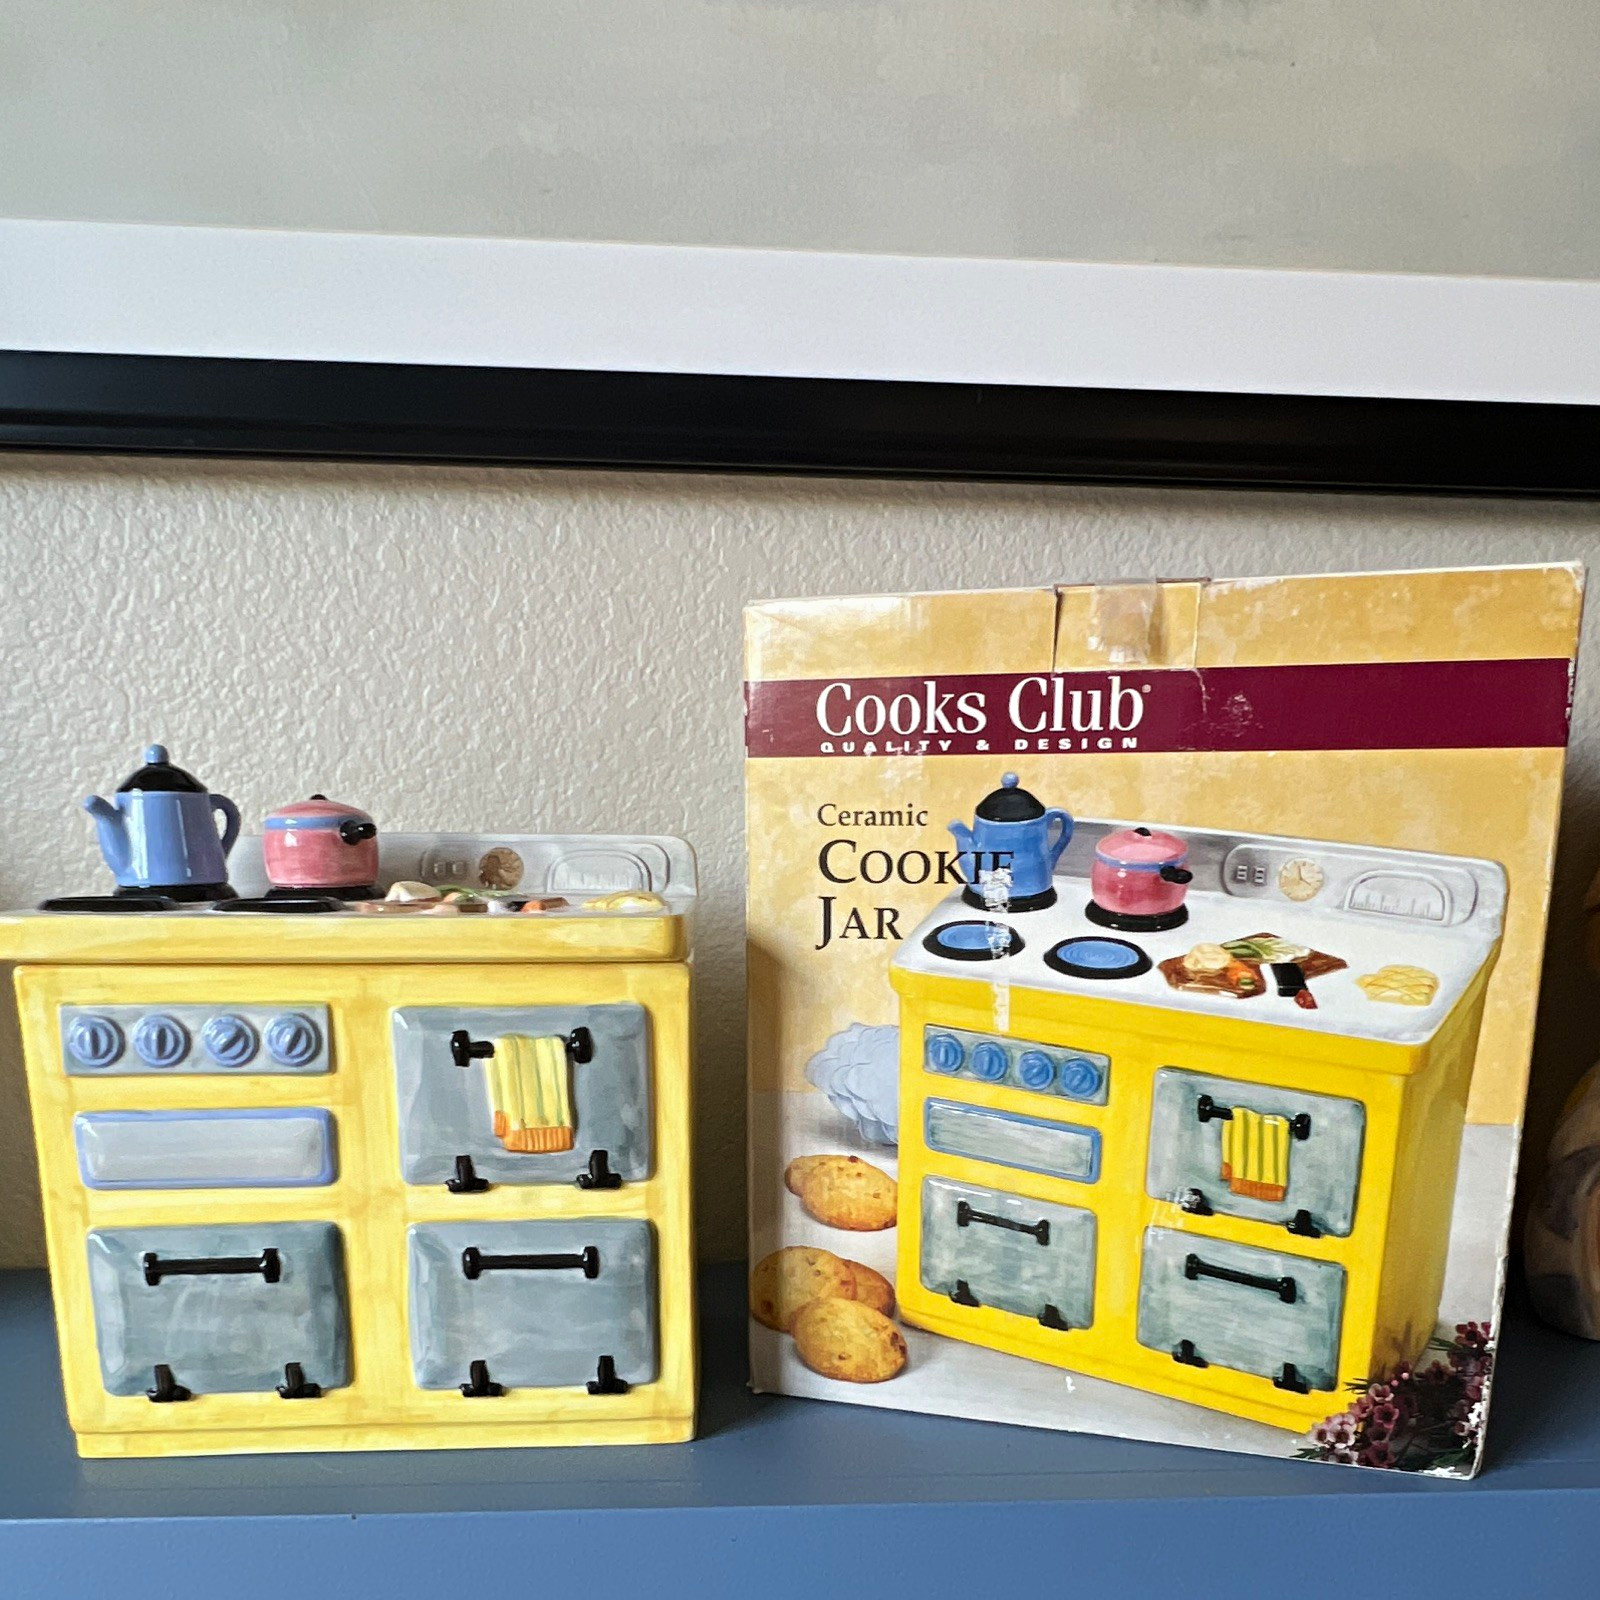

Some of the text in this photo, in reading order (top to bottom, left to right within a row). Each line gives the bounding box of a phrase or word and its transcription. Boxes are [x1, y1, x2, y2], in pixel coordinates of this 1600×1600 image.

[816, 681, 987, 736] Cooks
[820, 737, 1138, 754] QUALITY & DESIGN
[817, 803, 928, 827] Ceramic
[818, 839, 1015, 885] COOKIE
[815, 896, 904, 951] JAR
